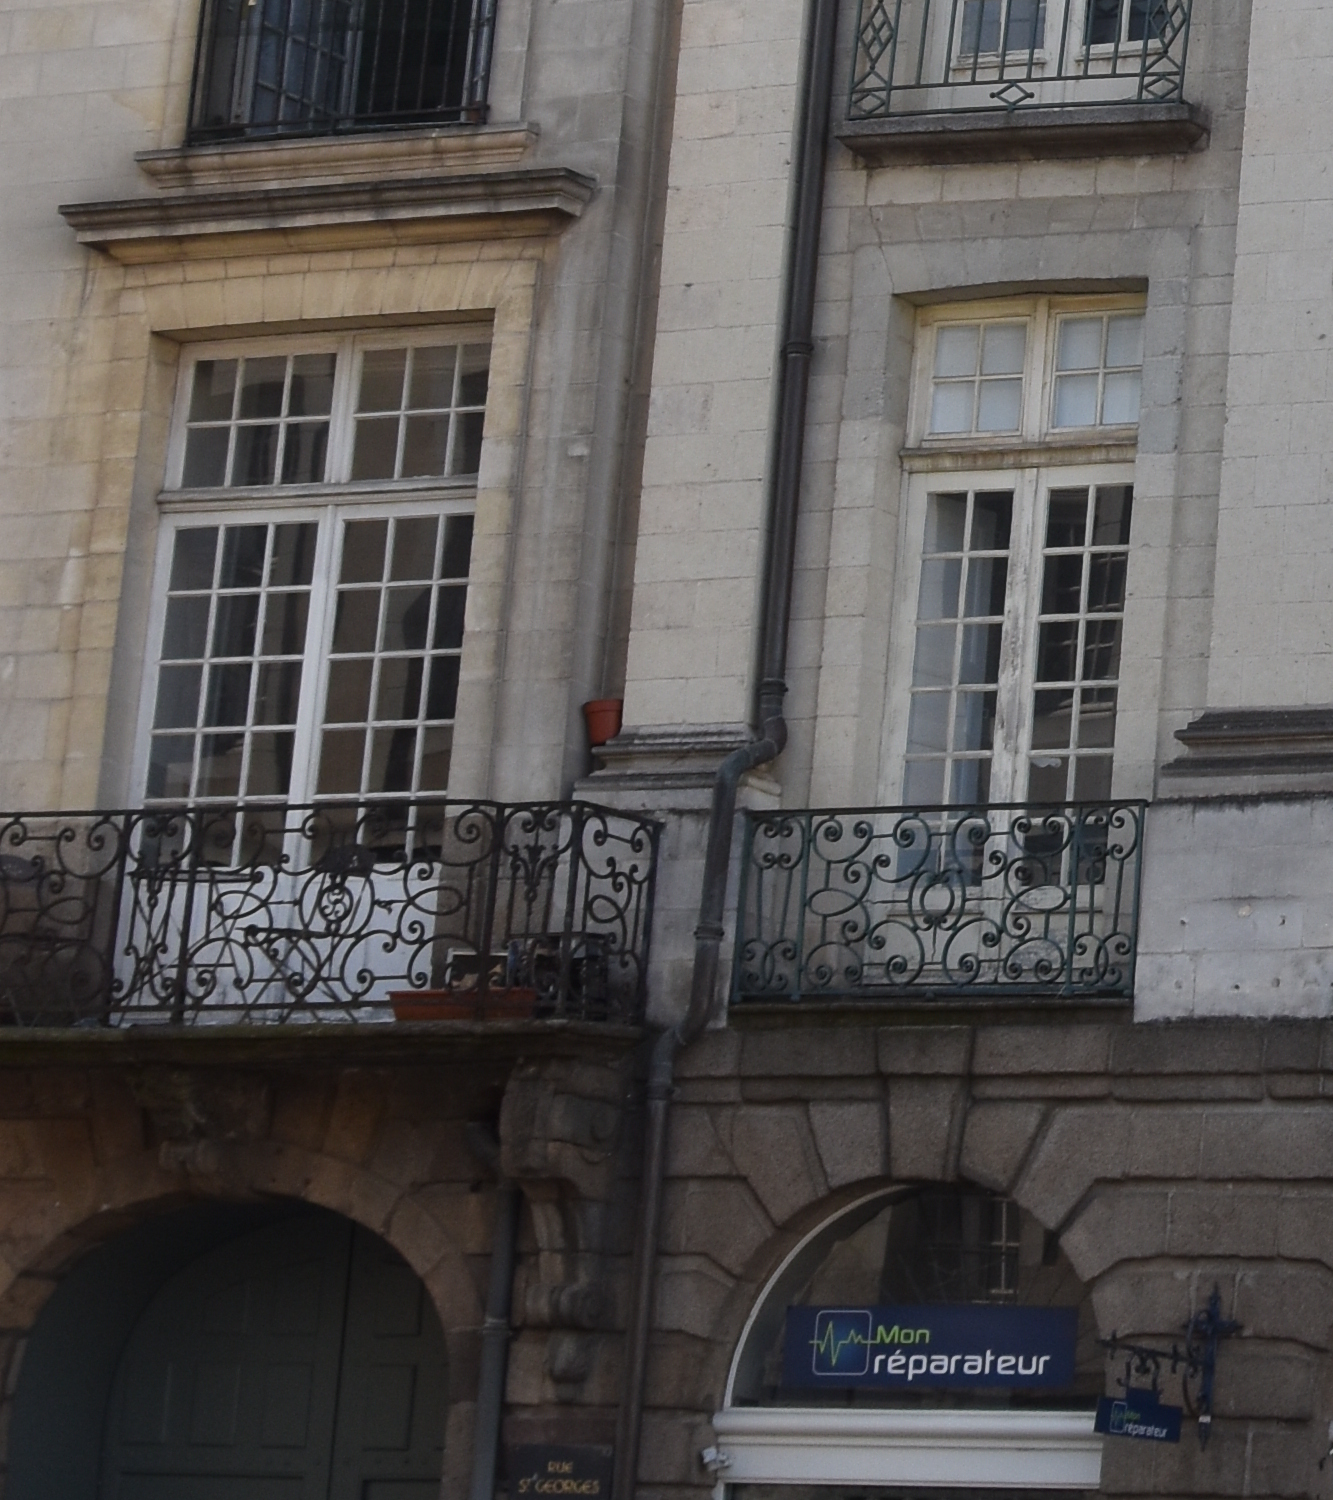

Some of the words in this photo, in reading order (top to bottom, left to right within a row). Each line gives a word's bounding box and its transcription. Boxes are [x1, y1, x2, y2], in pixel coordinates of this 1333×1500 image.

[875, 1325, 930, 1344] Mon
[873, 1349, 1051, 1381] réparateur
[547, 1461, 574, 1474] RUE
[535, 1479, 600, 1495] GEORGES
